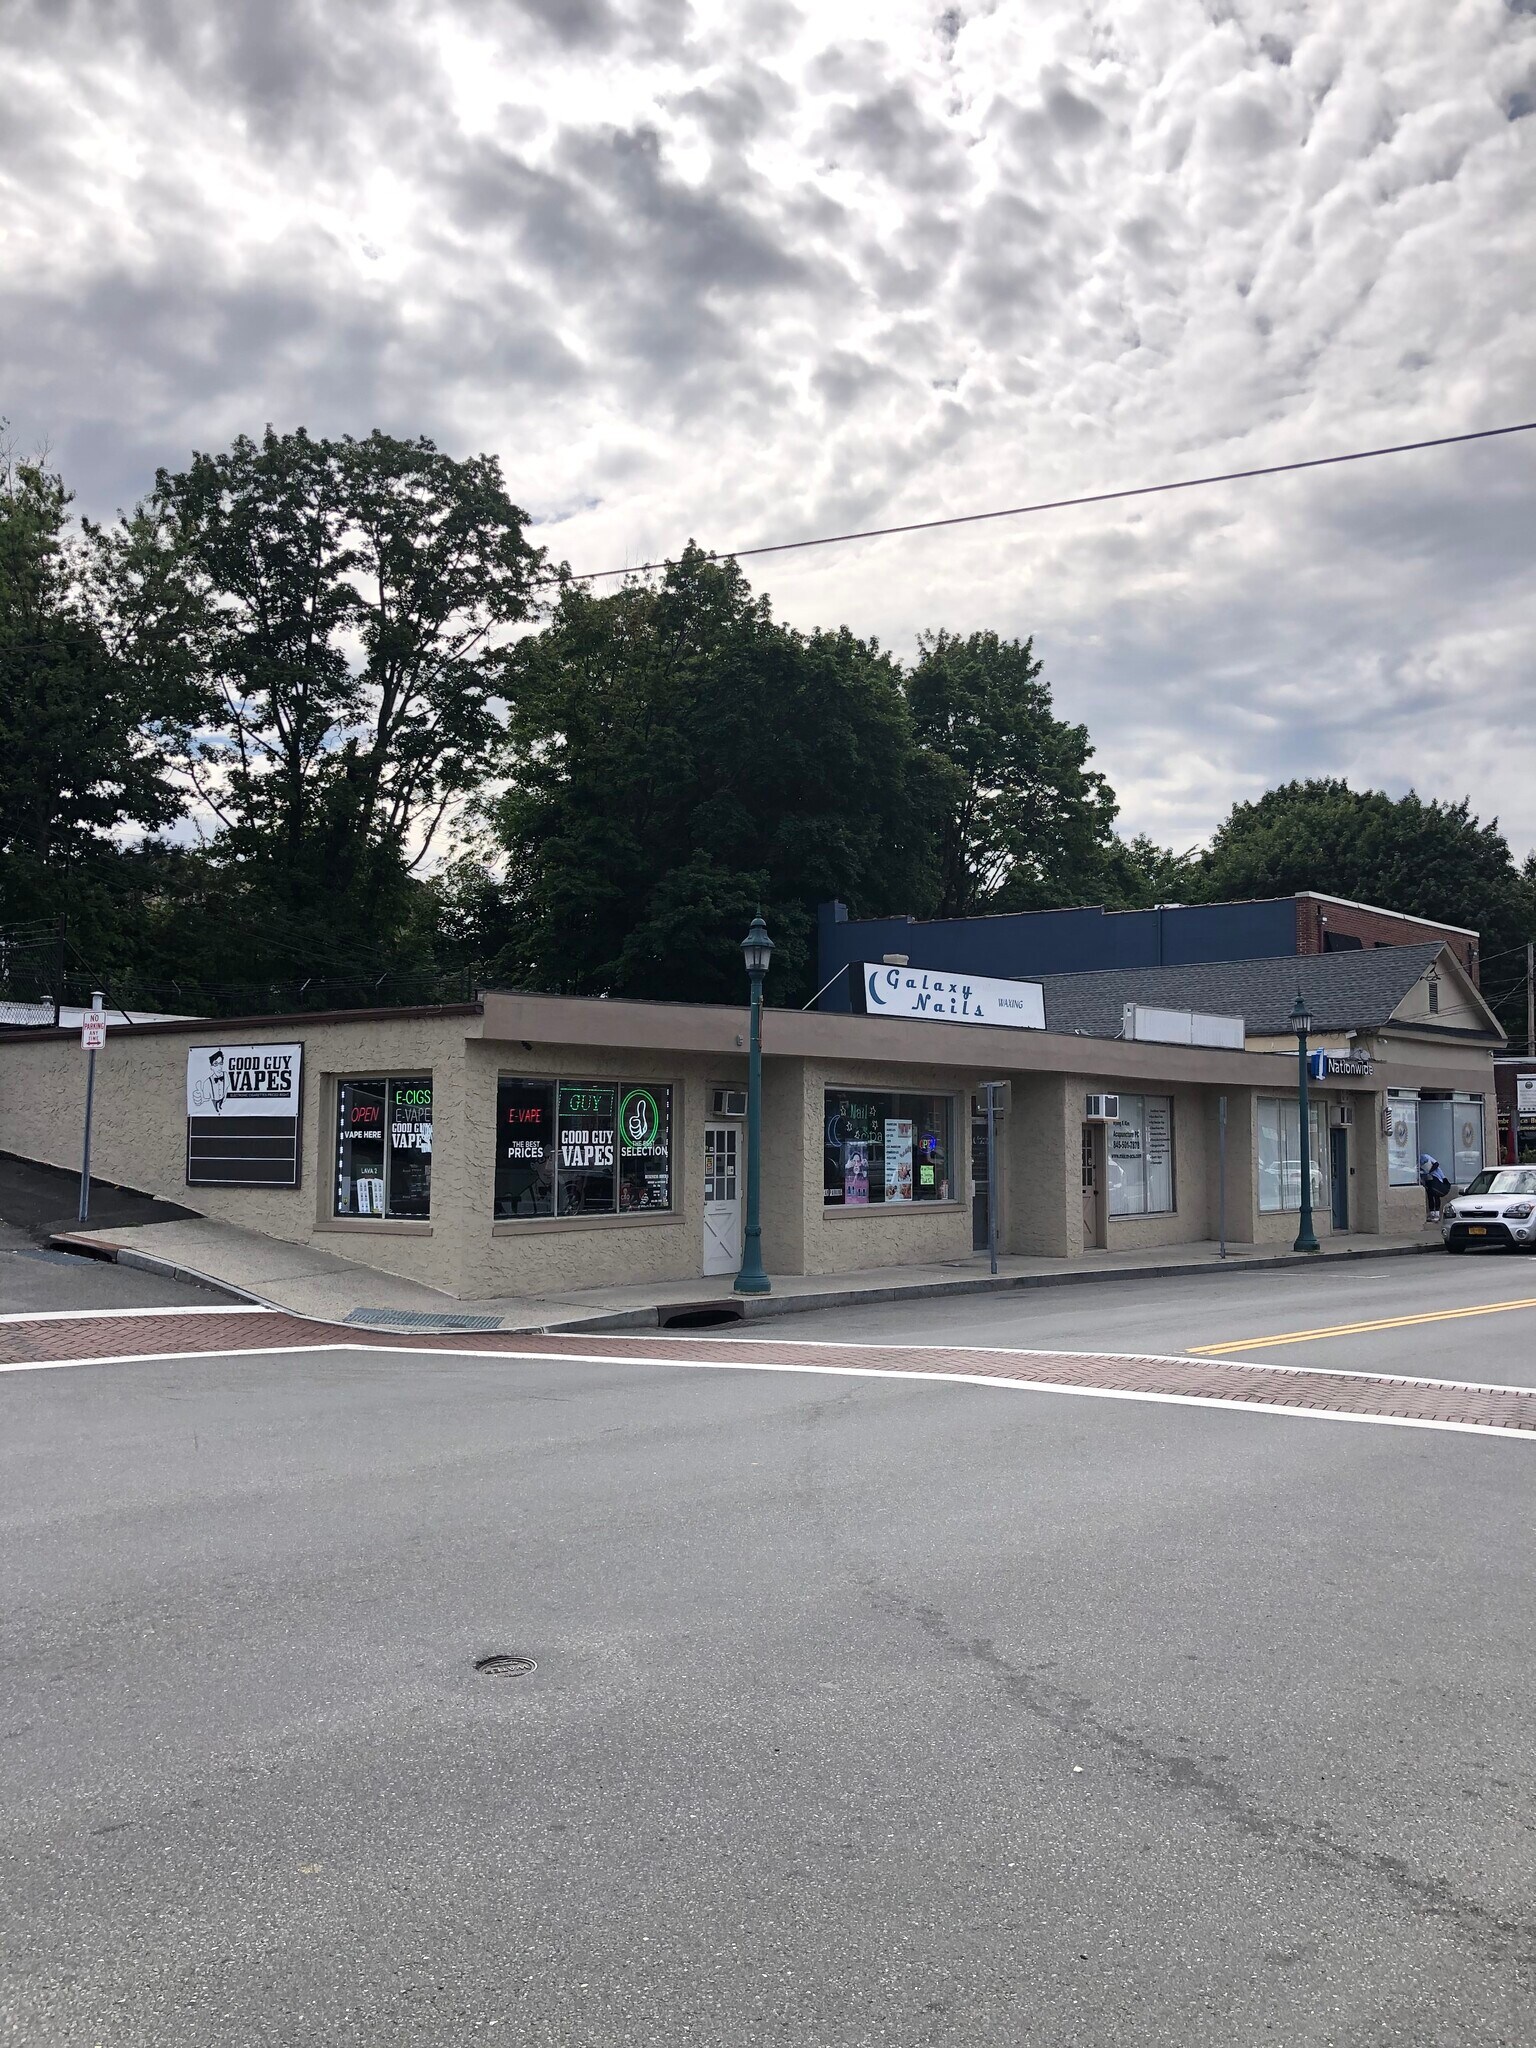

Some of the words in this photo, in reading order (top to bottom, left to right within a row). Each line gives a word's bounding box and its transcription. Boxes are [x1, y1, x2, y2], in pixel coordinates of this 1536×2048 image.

[886, 969, 972, 1000] Galaxy
[911, 993, 984, 1017] Nails
[998, 998, 1024, 1010] WAXING
[228, 1057, 260, 1070] GOOD
[264, 1056, 292, 1069] GUY
[1328, 1058, 1374, 1075] Nationwide
[228, 1070, 292, 1091] VAPES
[396, 1089, 431, 1105] E-CIGS
[569, 1094, 602, 1111] GUY
[351, 1106, 380, 1123] OPEN
[395, 1107, 431, 1123] E-VAPE
[508, 1108, 542, 1123] E-VAPE
[850, 1104, 868, 1120] Nail
[344, 1131, 362, 1139] VAPE
[363, 1131, 382, 1139] HERE
[392, 1123, 412, 1133] GOOD
[561, 1130, 589, 1144] GOOD
[592, 1130, 614, 1144] GUY
[508, 1147, 543, 1158] PRICES
[561, 1145, 614, 1167] VAPES
[621, 1146, 668, 1157] SELECTION
